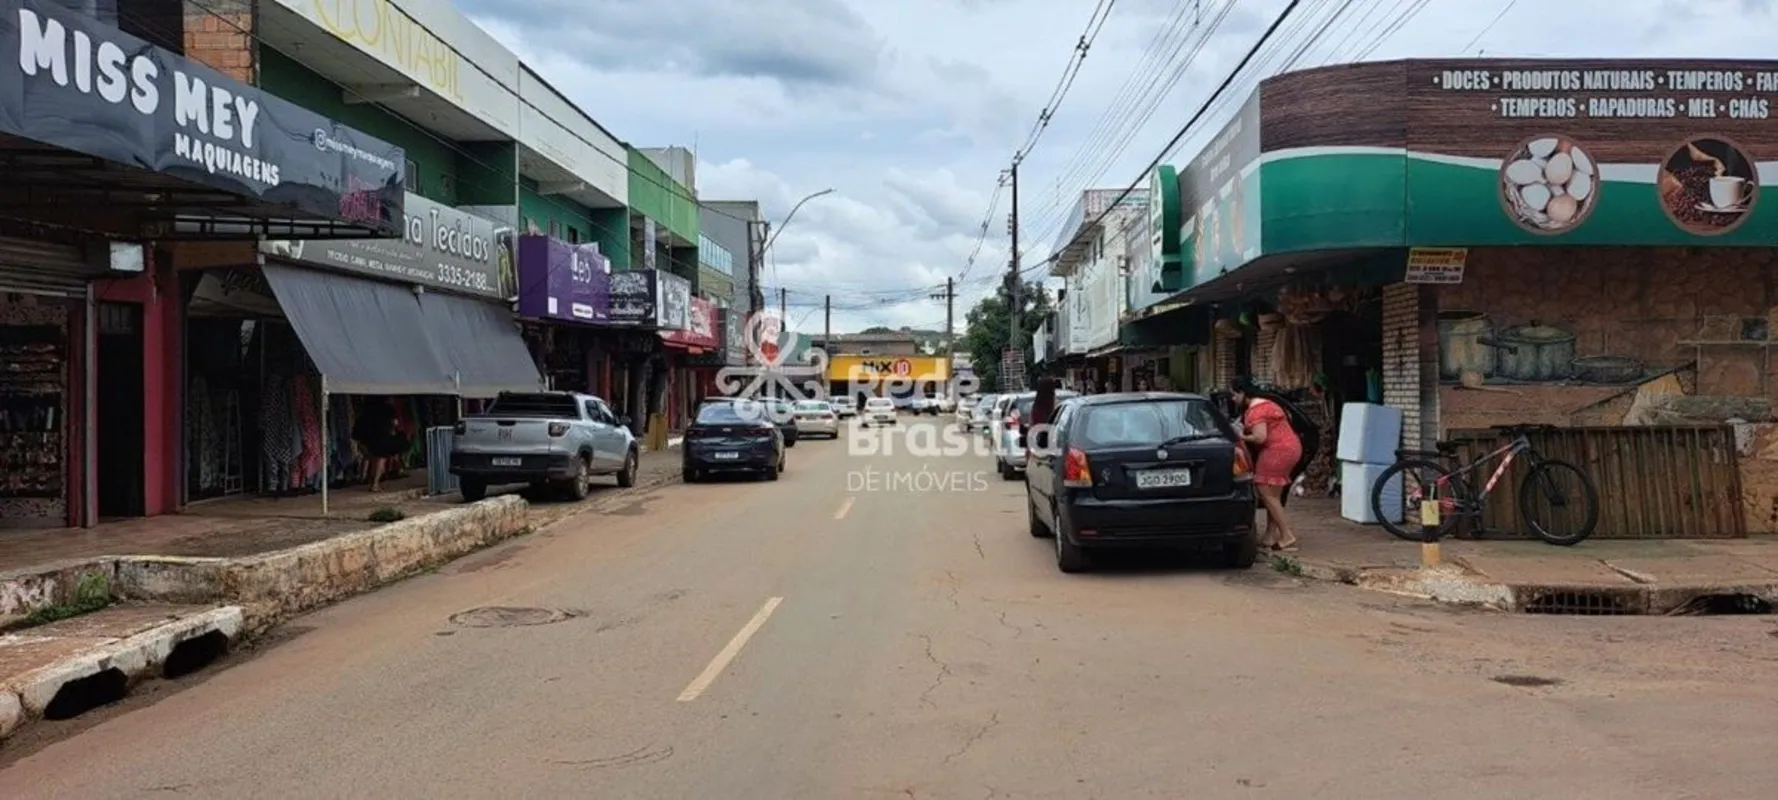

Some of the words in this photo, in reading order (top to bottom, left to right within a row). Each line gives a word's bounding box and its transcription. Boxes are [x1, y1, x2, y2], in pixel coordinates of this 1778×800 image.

[18, 8, 160, 116] MISS
[173, 70, 260, 149] MEY
[1442, 70, 1490, 90] DOCES
[1502, 70, 1580, 91] PRODUTOS
[1583, 70, 1655, 91] NATURAIS
[1668, 70, 1744, 91] TEMPEROS
[1501, 98, 1576, 118] TEMPEROS
[1589, 98, 1676, 118] RAPADURAS
[1688, 98, 1717, 118] MEL
[1729, 95, 1769, 119] CHÁS
[173, 131, 281, 188] MAQUIAGENS
[430, 208, 490, 263] Tecidos
[437, 262, 487, 291] 3335-2188
